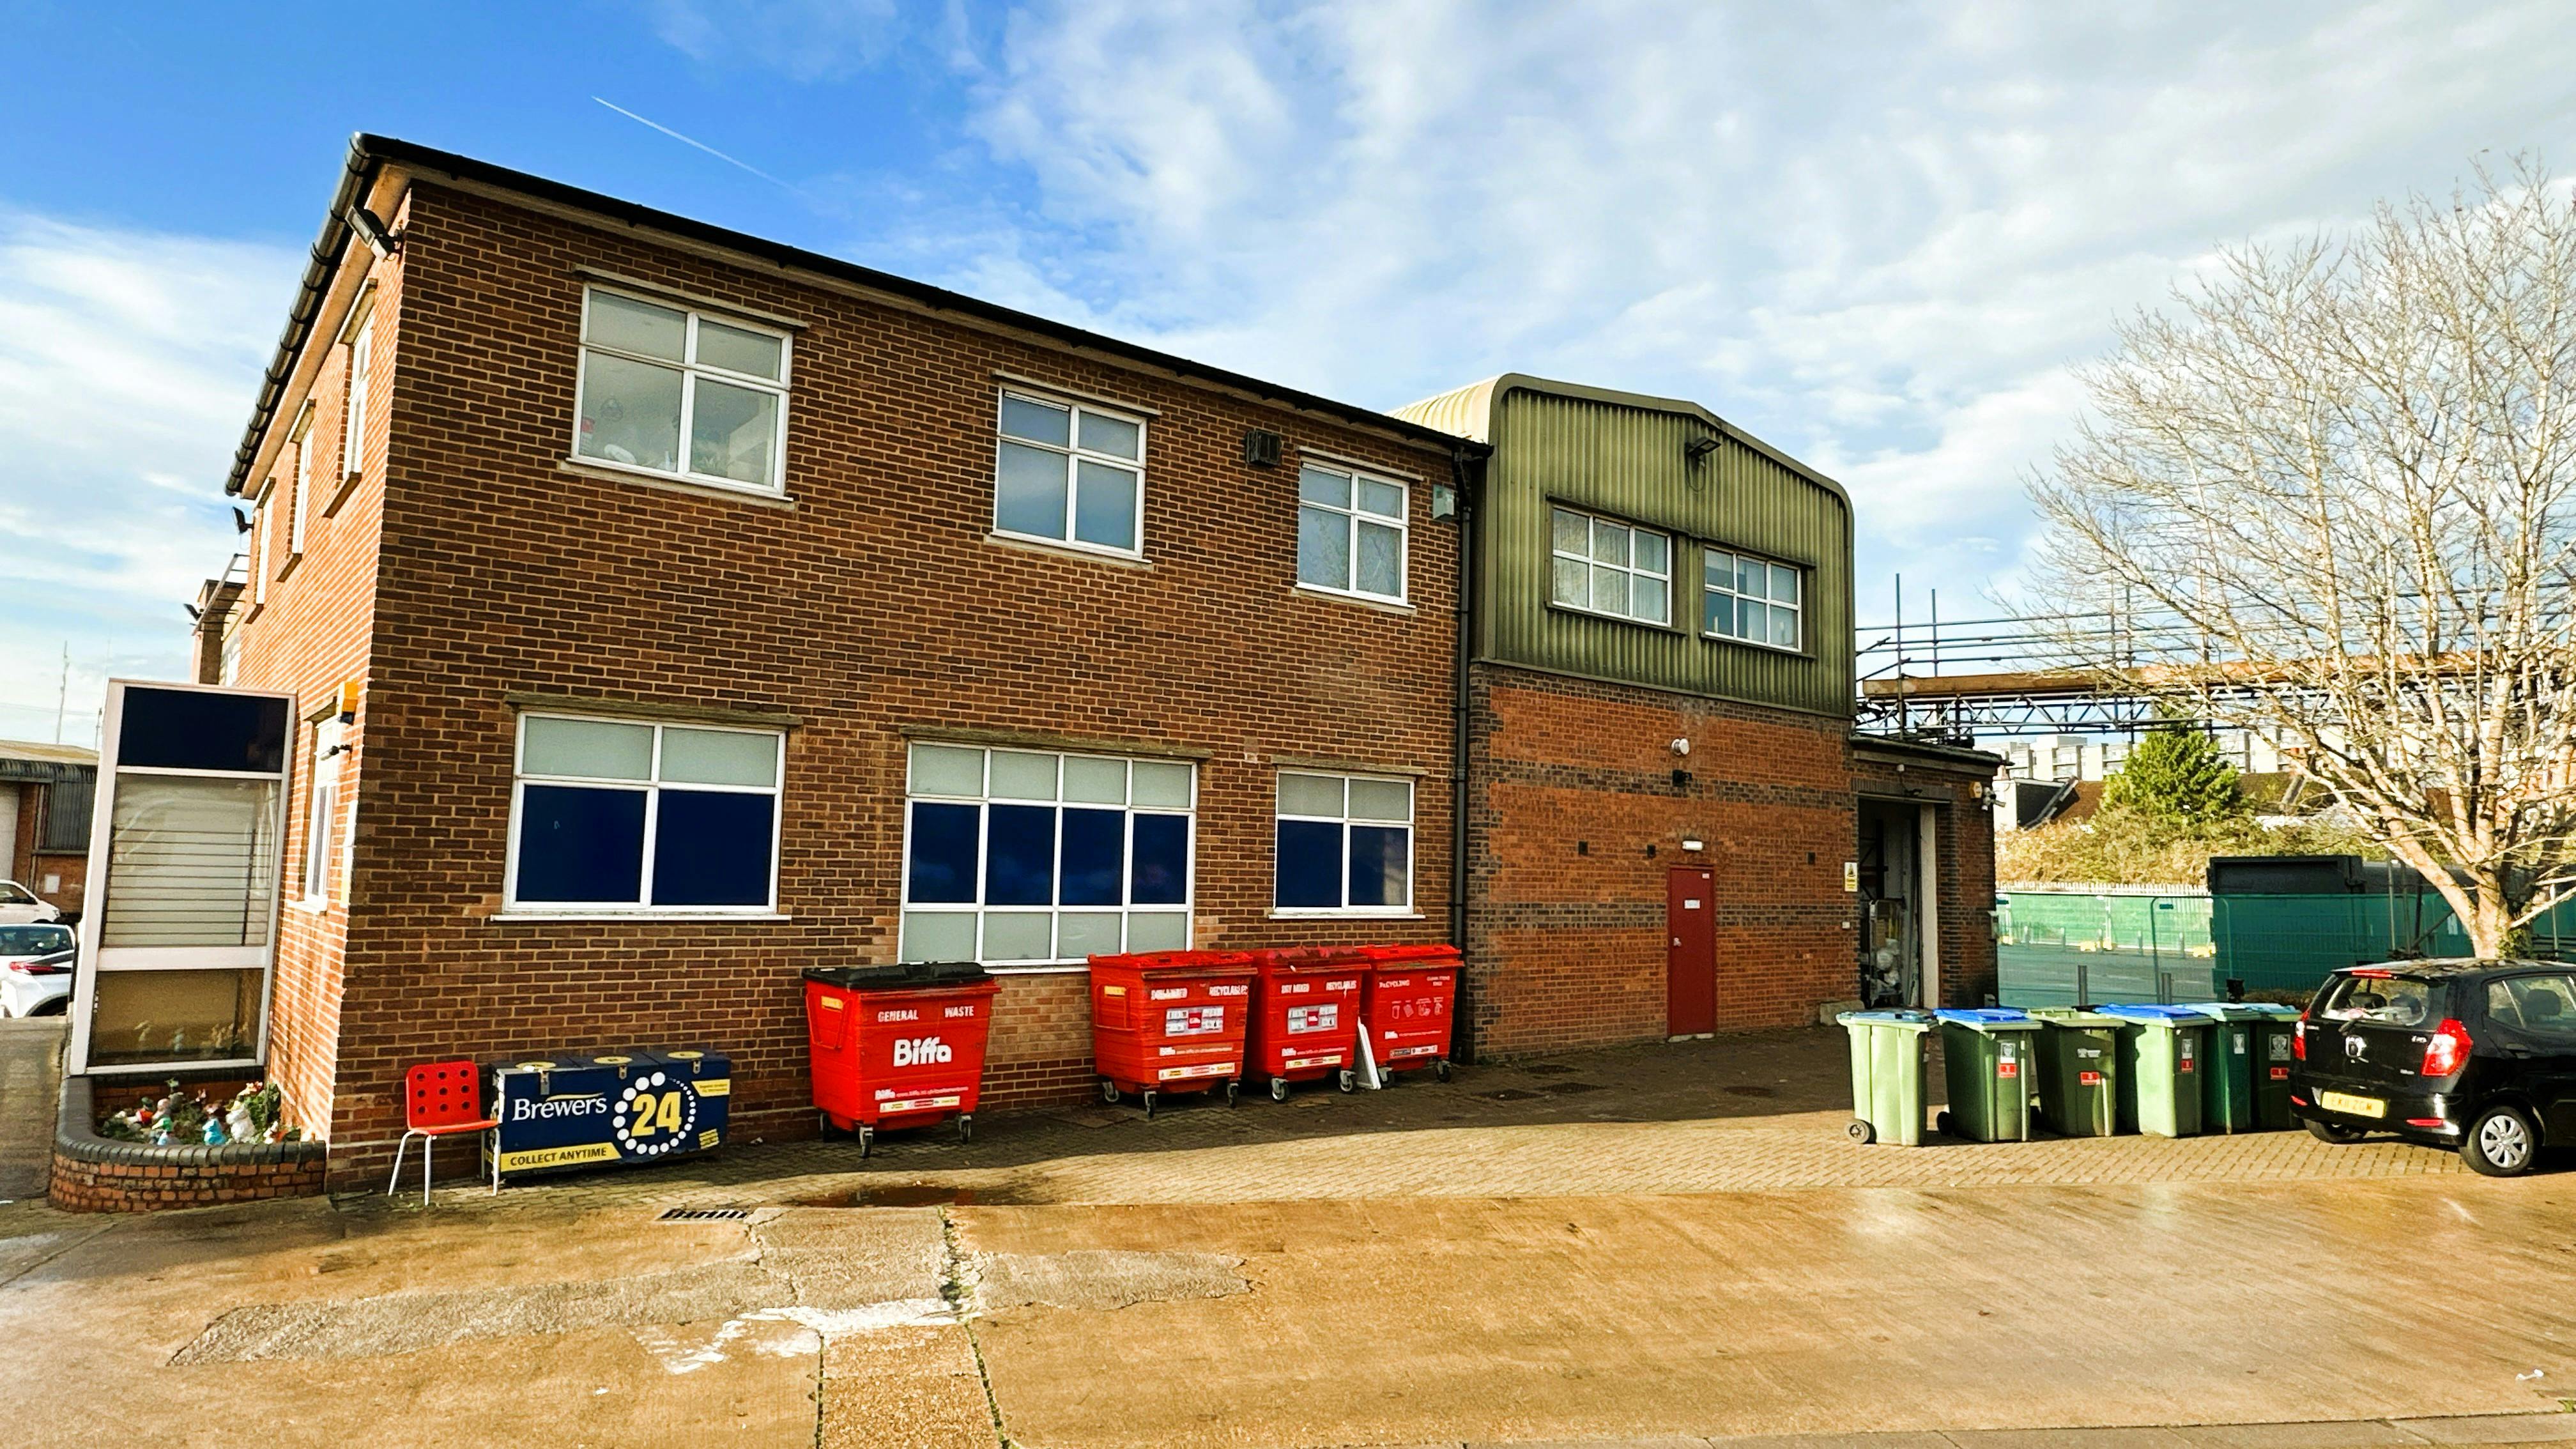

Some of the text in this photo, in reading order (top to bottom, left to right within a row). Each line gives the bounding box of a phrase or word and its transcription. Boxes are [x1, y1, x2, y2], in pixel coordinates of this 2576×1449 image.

[1209, 985, 1248, 997] RECYCLABLES
[1379, 979, 1410, 988] RECYCLING
[878, 1006, 974, 1022] GENERAL WASTE
[894, 1037, 951, 1066] Biffa
[512, 1096, 607, 1121] Brewers
[631, 1091, 682, 1138] 24
[510, 1147, 607, 1167] COLLECT ANYTIME
